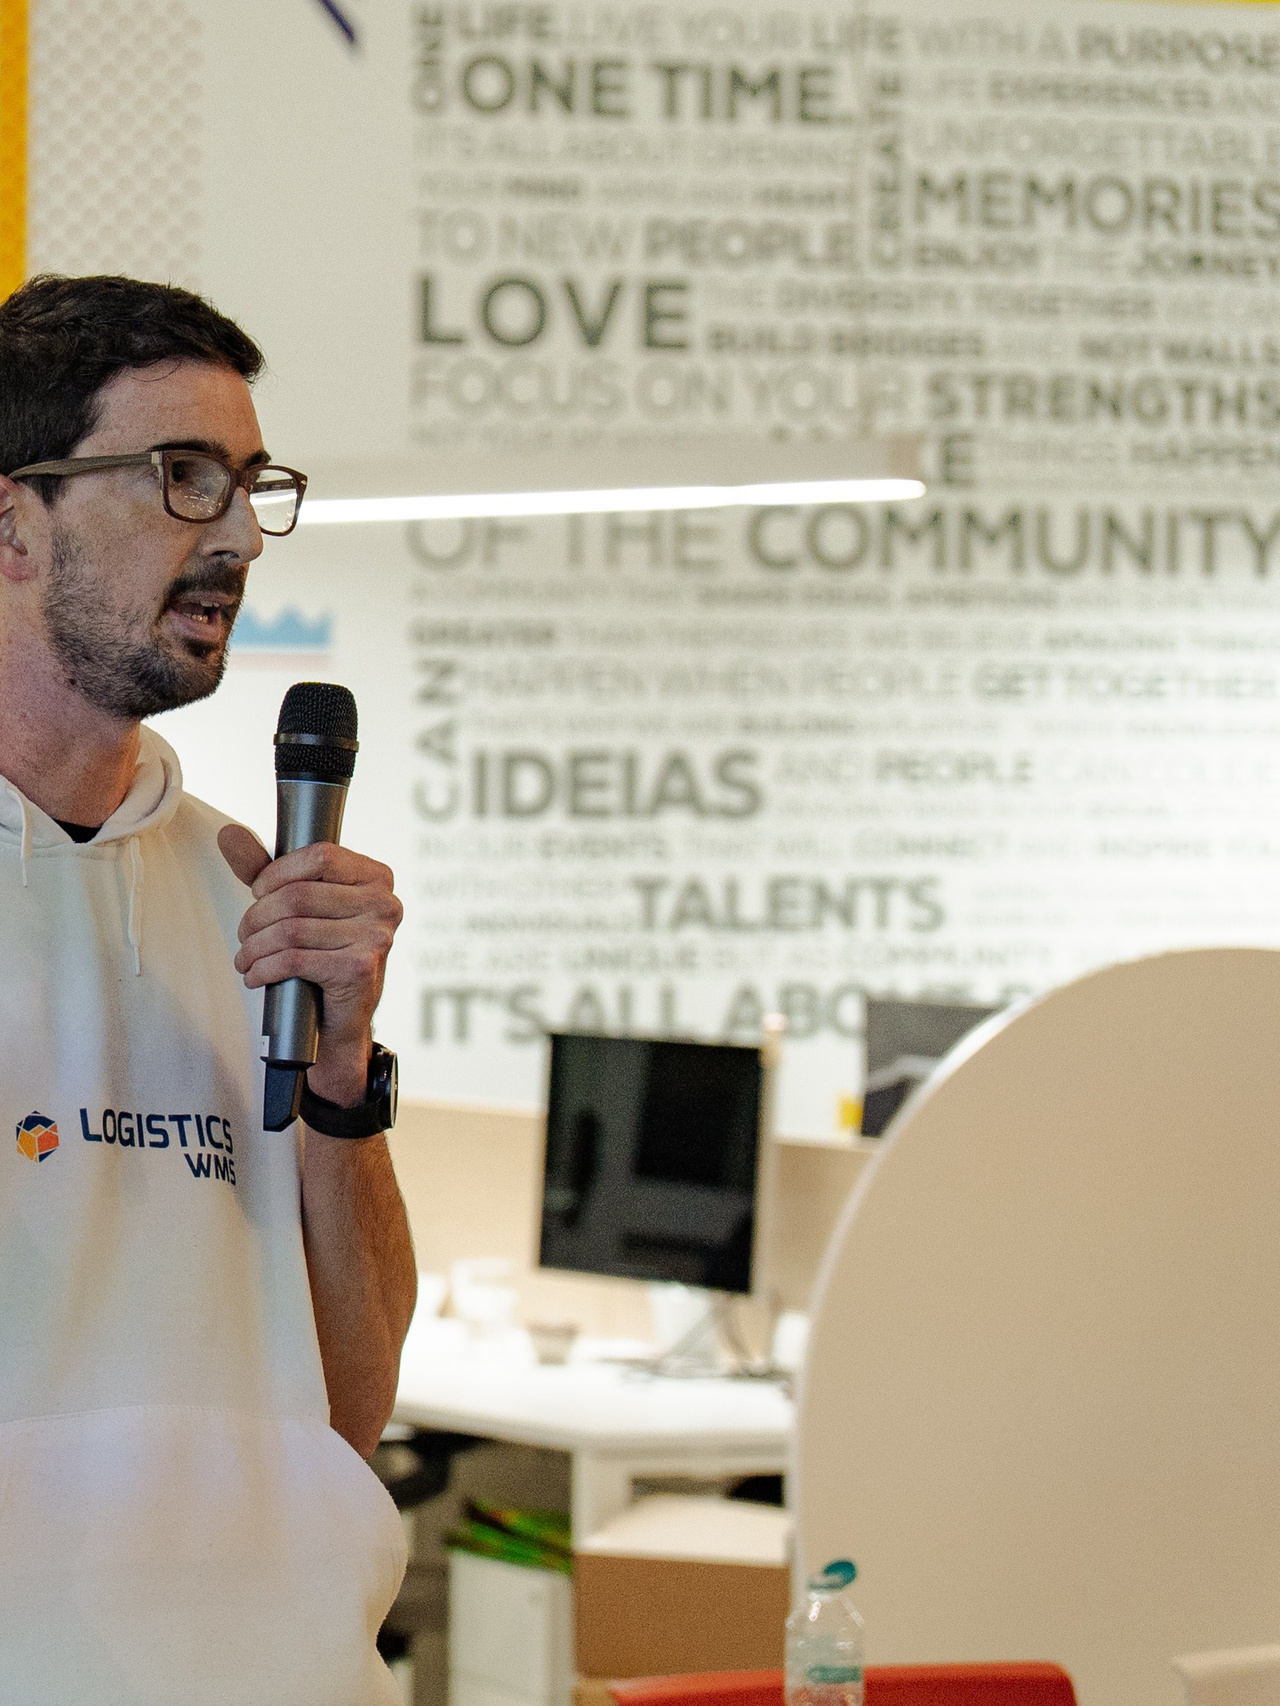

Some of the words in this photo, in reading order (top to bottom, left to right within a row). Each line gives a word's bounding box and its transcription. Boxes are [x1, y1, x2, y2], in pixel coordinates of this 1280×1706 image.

[1076, 24, 1280, 72] PURPOSE
[459, 54, 630, 117] ONE
[915, 170, 1280, 241] MEMORIES
[414, 271, 692, 352] LOVE
[926, 368, 1280, 428] STRENGTHS
[745, 502, 1280, 580] COMMUNITY
[470, 747, 768, 822] IDEIAS
[874, 748, 1036, 788] PEOPLE
[628, 873, 948, 936] TALENTS
[79, 1107, 233, 1154] LOGISTICS
[183, 1152, 236, 1186] WMS
